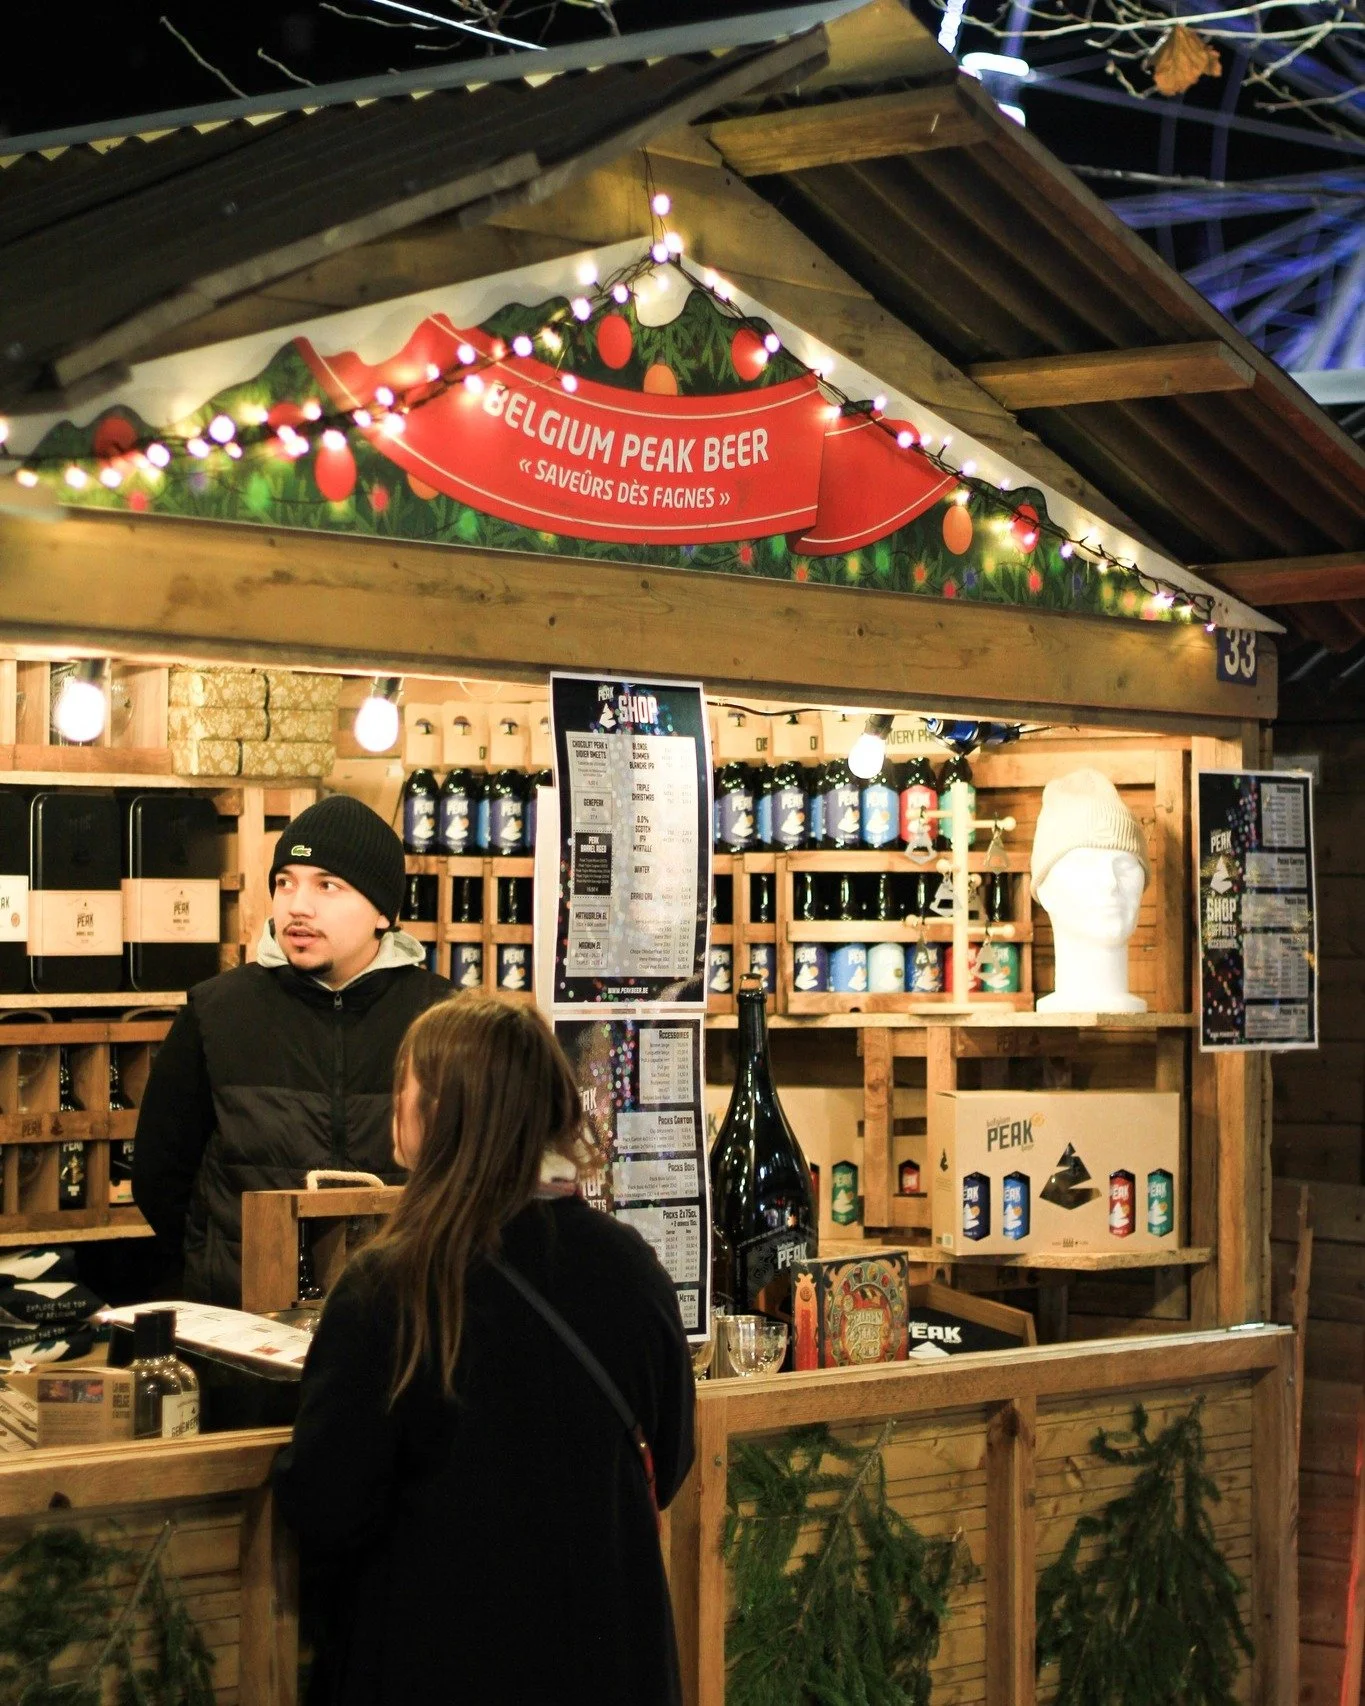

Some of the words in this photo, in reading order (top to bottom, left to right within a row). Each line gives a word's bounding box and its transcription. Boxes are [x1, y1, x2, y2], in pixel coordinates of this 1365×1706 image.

[484, 380, 615, 464] BELGIUM
[620, 433, 696, 473] PEAK
[703, 428, 769, 472] BEER
[617, 478, 648, 506] DÈS
[652, 486, 715, 509] FAGNES
[1224, 627, 1256, 678] 33
[618, 695, 658, 725] SHOP
[636, 784, 650, 792] TRIPLE
[631, 794, 655, 802] CHRISTMAS
[637, 815, 649, 823] 0.0%
[635, 825, 651, 833] SCOTCH
[1210, 830, 1232, 853] PEAK
[633, 844, 652, 853] MYRTILLE
[634, 866, 650, 874] WINTER
[173, 902, 190, 916] PEAK
[1206, 898, 1237, 922] SHOP
[76, 913, 94, 928] PEAK
[658, 1030, 690, 1040] ACCESSOIRES
[658, 1115, 673, 1125] PACKS
[673, 1115, 693, 1125] CARTON
[987, 1118, 1034, 1152] PEAK
[667, 1162, 683, 1172] PACKS
[963, 1185, 980, 1201] EAK
[663, 1210, 678, 1220] PACKS
[777, 1243, 808, 1270] PEAK
[679, 1294, 696, 1302] METAL
[26, 1303, 55, 1313] EXPLORE
[73, 1300, 87, 1308] TOP
[908, 1325, 961, 1340] EAK
